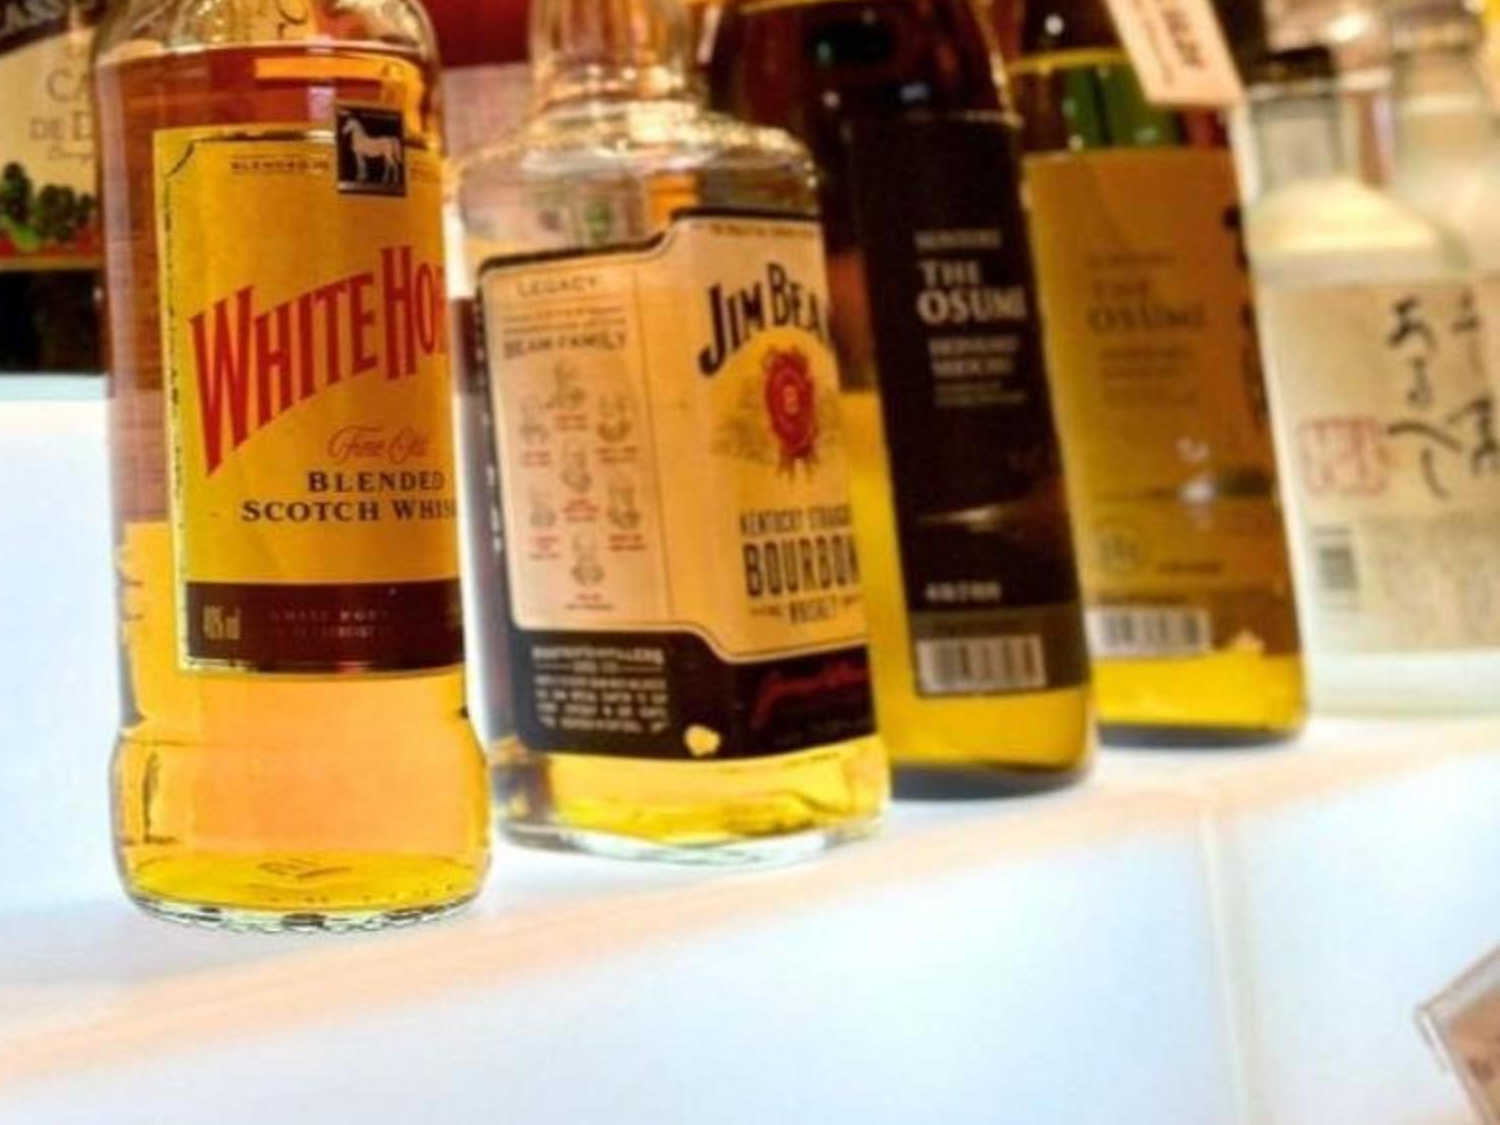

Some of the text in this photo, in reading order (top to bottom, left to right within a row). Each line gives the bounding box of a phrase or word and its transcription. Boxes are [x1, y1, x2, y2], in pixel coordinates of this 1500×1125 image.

[698, 261, 827, 377] JIM BEA
[188, 270, 377, 479] WHITE
[240, 499, 380, 523] SCOTCH
[307, 471, 446, 493] BLENDED
